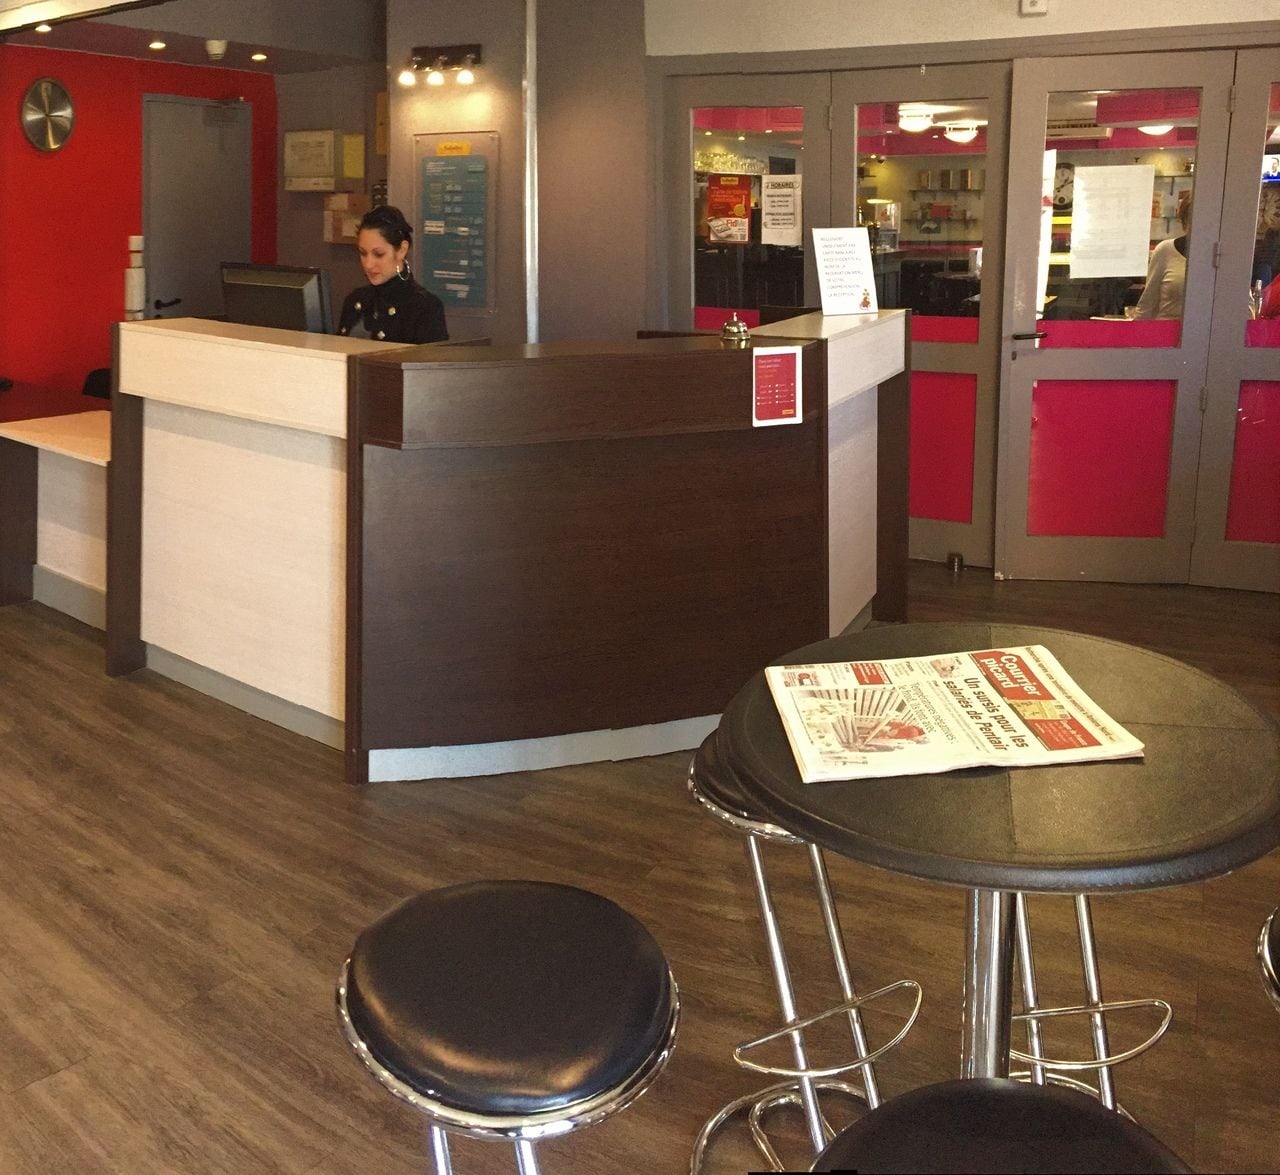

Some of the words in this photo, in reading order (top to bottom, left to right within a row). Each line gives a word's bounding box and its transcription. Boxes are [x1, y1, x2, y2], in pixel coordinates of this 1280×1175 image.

[981, 658, 1020, 689] picard
[1001, 655, 1041, 696] Courrier
[943, 680, 974, 709] salariés
[966, 710, 984, 721] de
[975, 722, 1009, 751] Pentair
[964, 677, 981, 689] Un
[973, 690, 1001, 714] sursis
[990, 715, 1017, 734] pour
[1009, 734, 1030, 749] les
